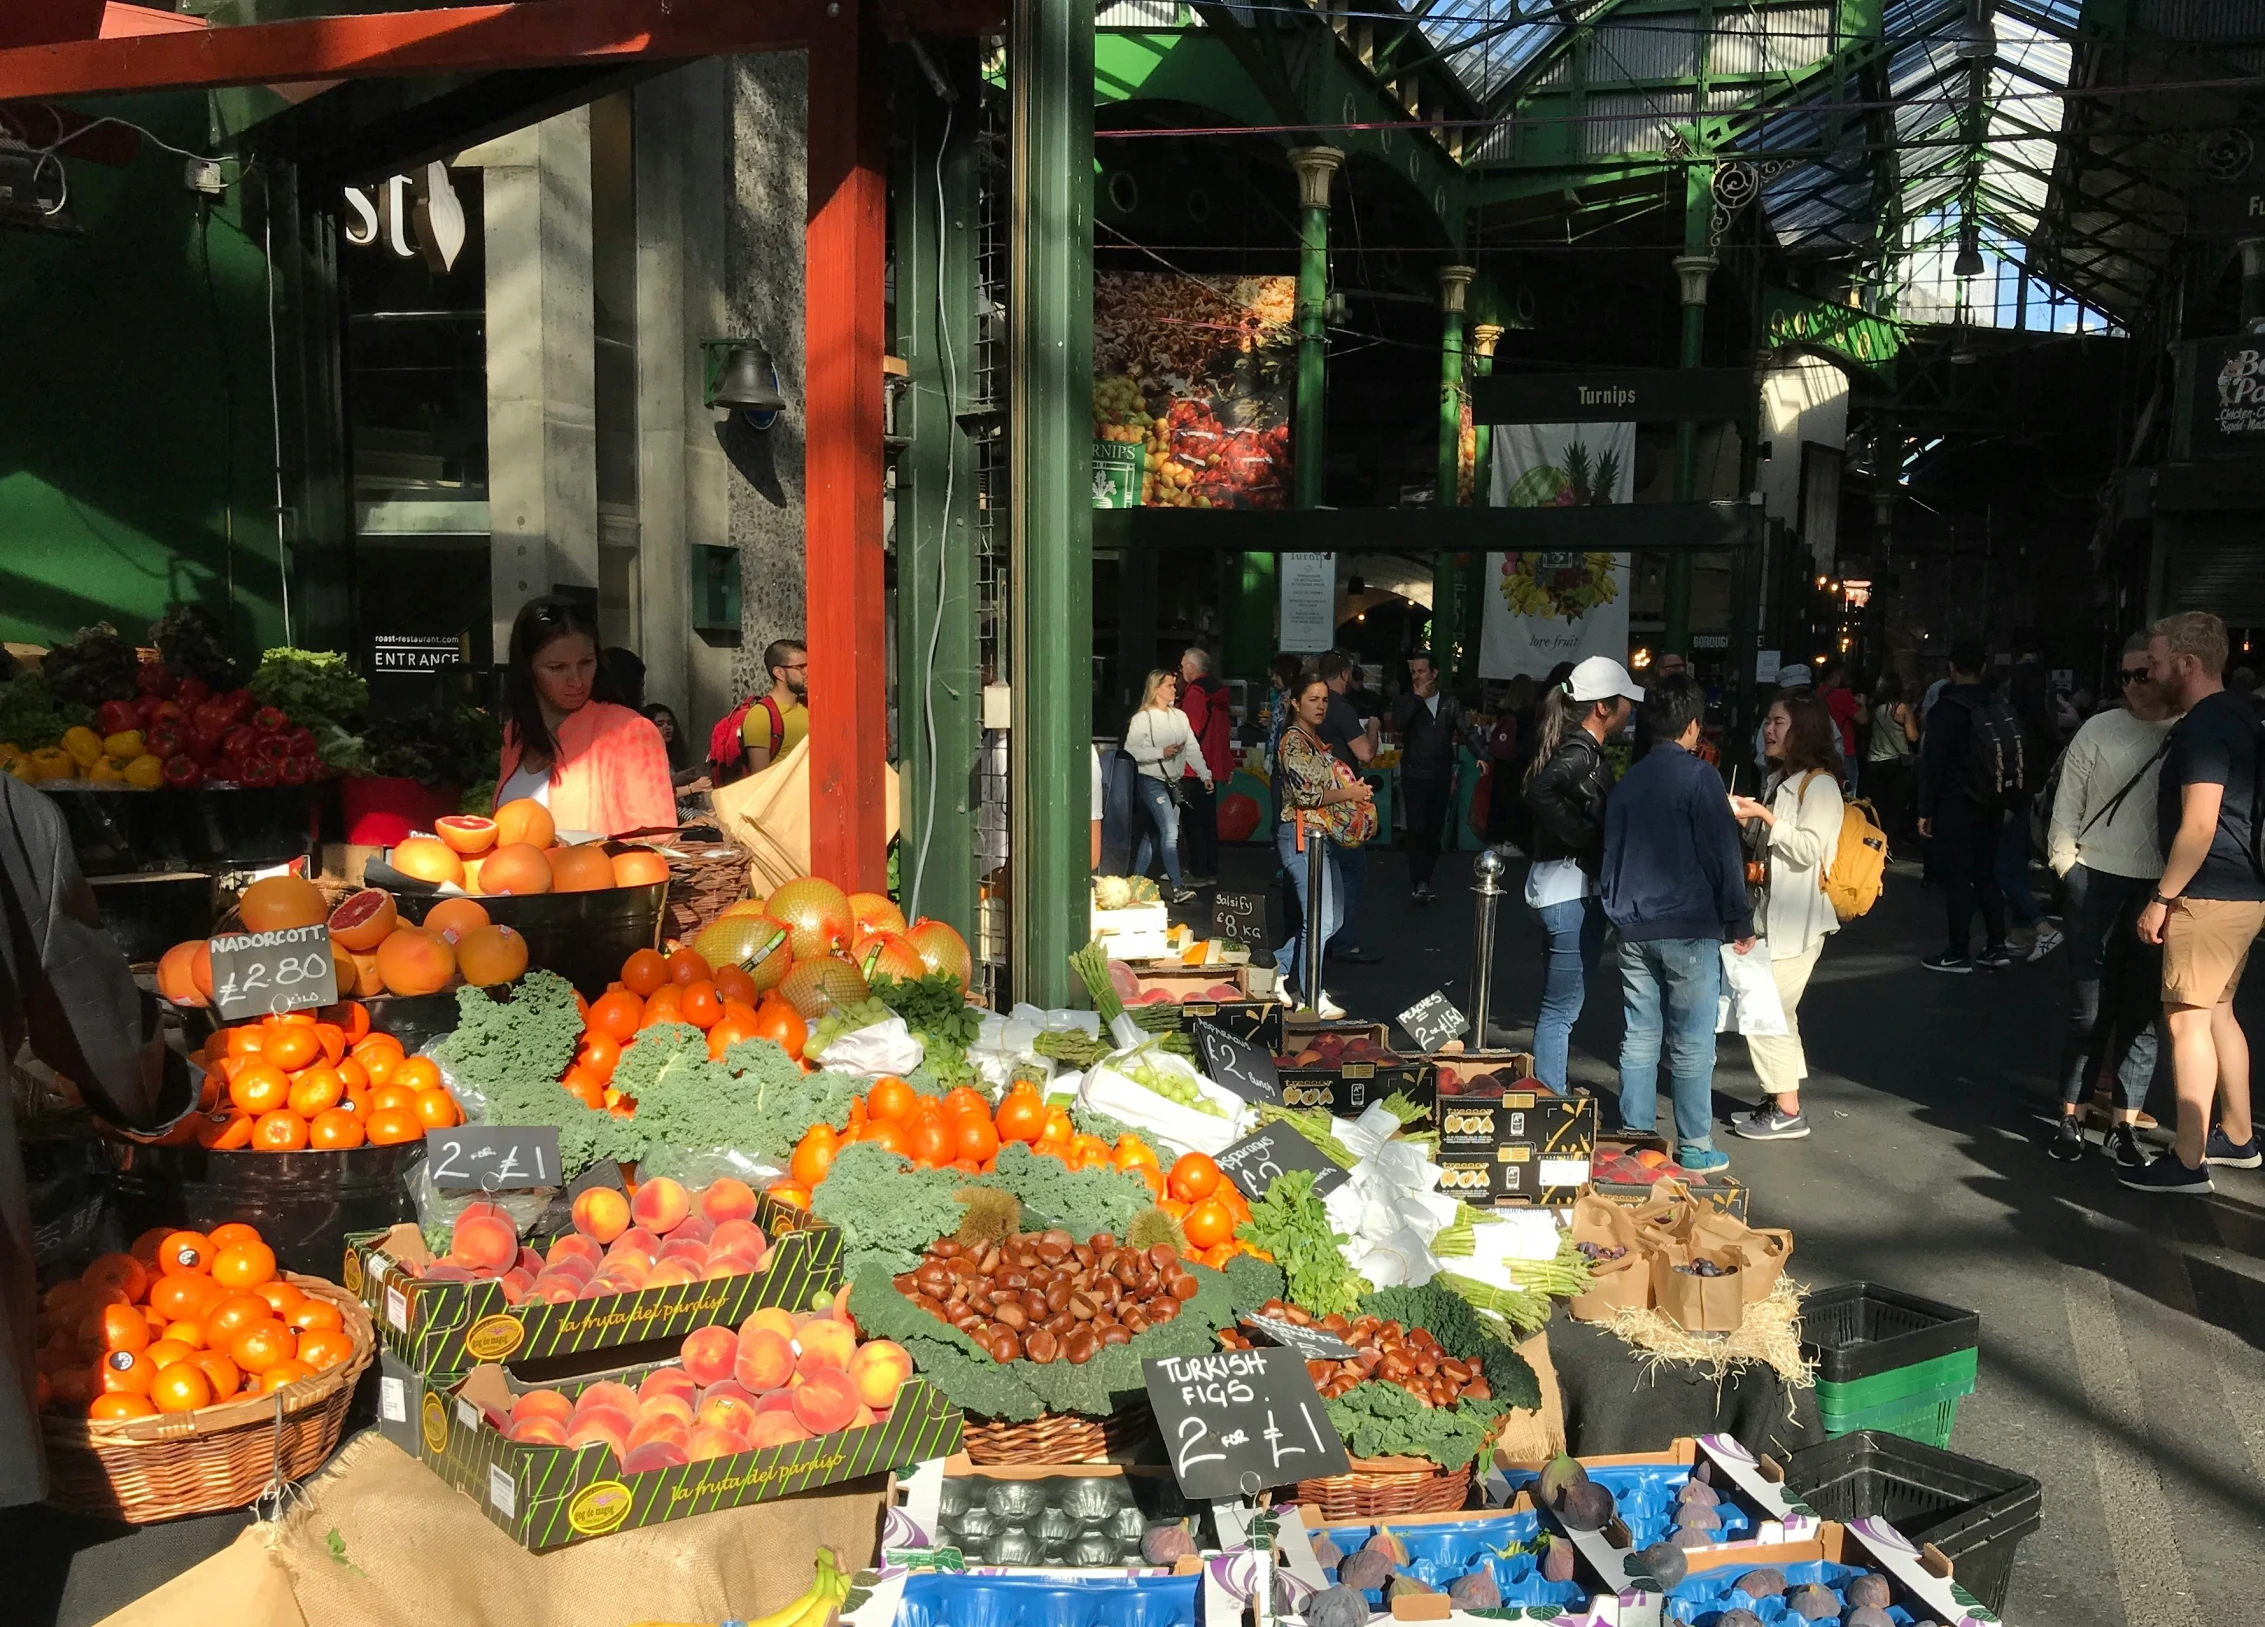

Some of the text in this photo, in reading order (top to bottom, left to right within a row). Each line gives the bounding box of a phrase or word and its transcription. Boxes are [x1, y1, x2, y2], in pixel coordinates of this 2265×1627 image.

[1578, 385, 1636, 407] Turnips
[1291, 552, 1323, 569] Turnip
[375, 635, 459, 643] roast-restaurant.com
[1529, 635, 1580, 651] love fruit
[375, 652, 460, 666] ENTRANCE
[1216, 894, 1252, 915] Salsify
[1243, 925, 1261, 939] KG
[1415, 1027, 1435, 1051] 2
[1206, 1034, 1246, 1080] £2
[433, 1141, 470, 1180] 2
[498, 1145, 546, 1183] £1
[1214, 1136, 1275, 1171] Asparagus
[556, 1319, 579, 1334] la
[580, 1310, 630, 1332] fruta
[631, 1304, 664, 1320] del
[1157, 1351, 1268, 1383] TURKISH
[1178, 1402, 1326, 1479] 2 FOR £1
[672, 1486, 694, 1501] la
[695, 1477, 745, 1499] fruta
[746, 1465, 778, 1485] del
